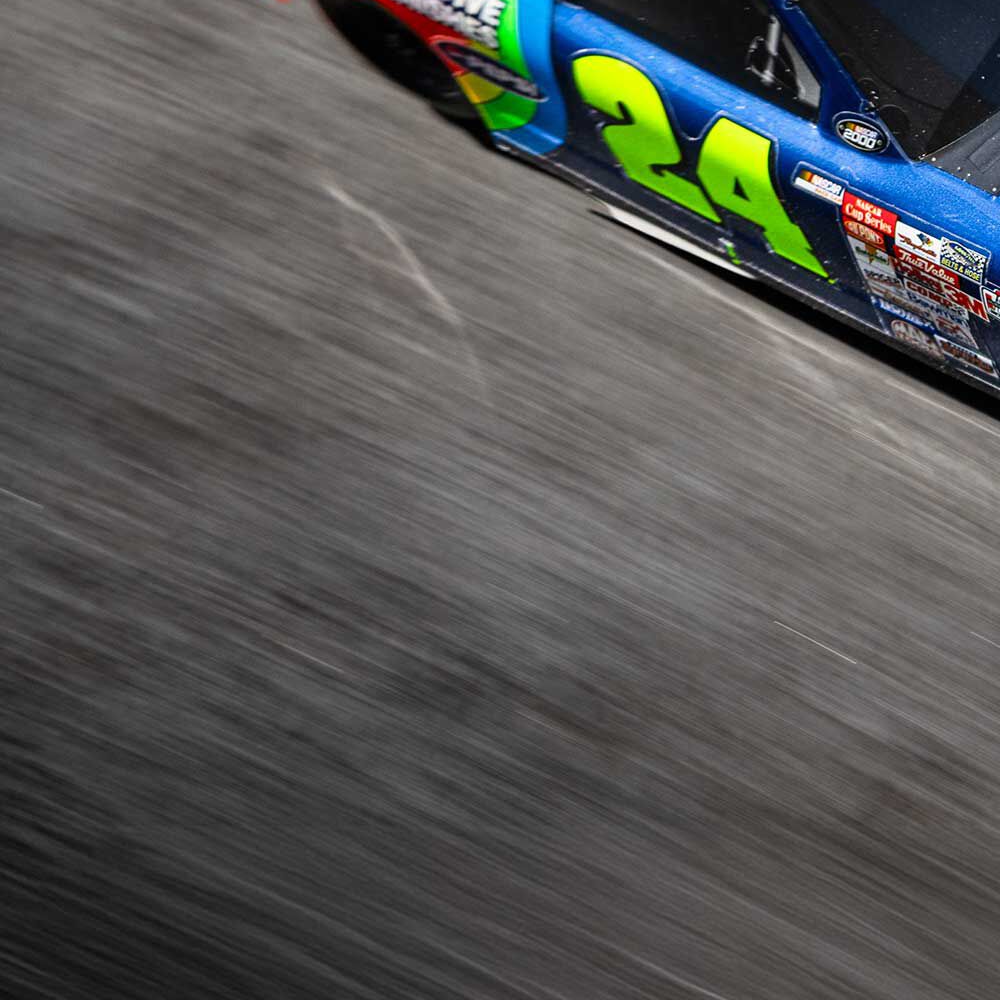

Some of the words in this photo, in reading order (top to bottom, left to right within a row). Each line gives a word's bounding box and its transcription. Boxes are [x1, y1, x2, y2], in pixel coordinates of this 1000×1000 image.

[843, 128, 877, 149] 2000
[571, 54, 830, 279] 24
[812, 174, 842, 196] NASCAR
[845, 203, 864, 221] Cup
[864, 212, 893, 234] Series
[855, 198, 882, 217] NASCAR
[941, 257, 959, 273] BELTS
[964, 268, 980, 281] HOSE
[942, 284, 989, 322] 3M
